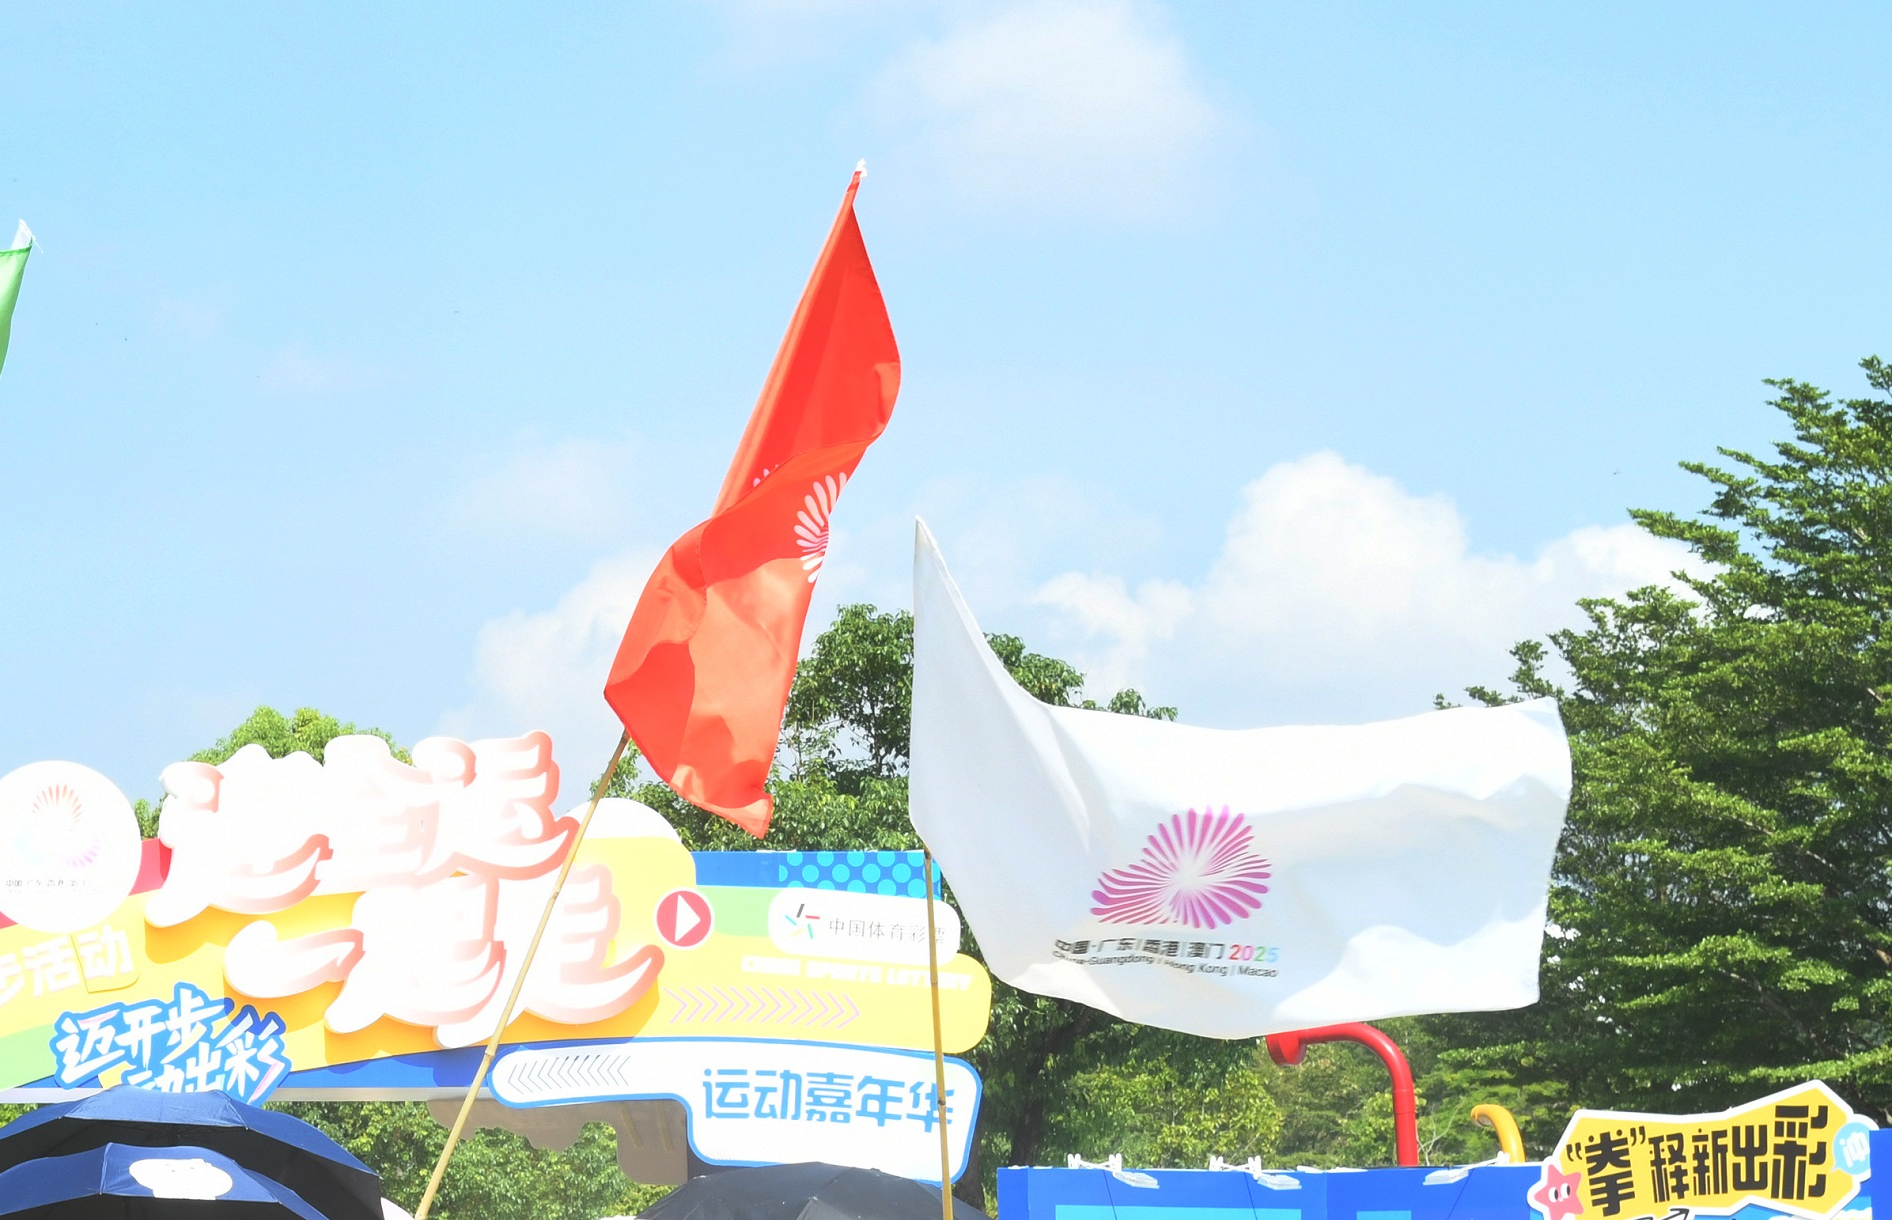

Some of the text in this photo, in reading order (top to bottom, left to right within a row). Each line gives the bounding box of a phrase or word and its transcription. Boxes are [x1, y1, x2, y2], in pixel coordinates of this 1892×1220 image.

[1197, 962, 1229, 977] Kong
[1238, 965, 1279, 979] Macao
[1229, 944, 1280, 963] 2025
[56, 987, 226, 1084] 迈开步
[702, 1067, 954, 1133] 运动嘉年华
